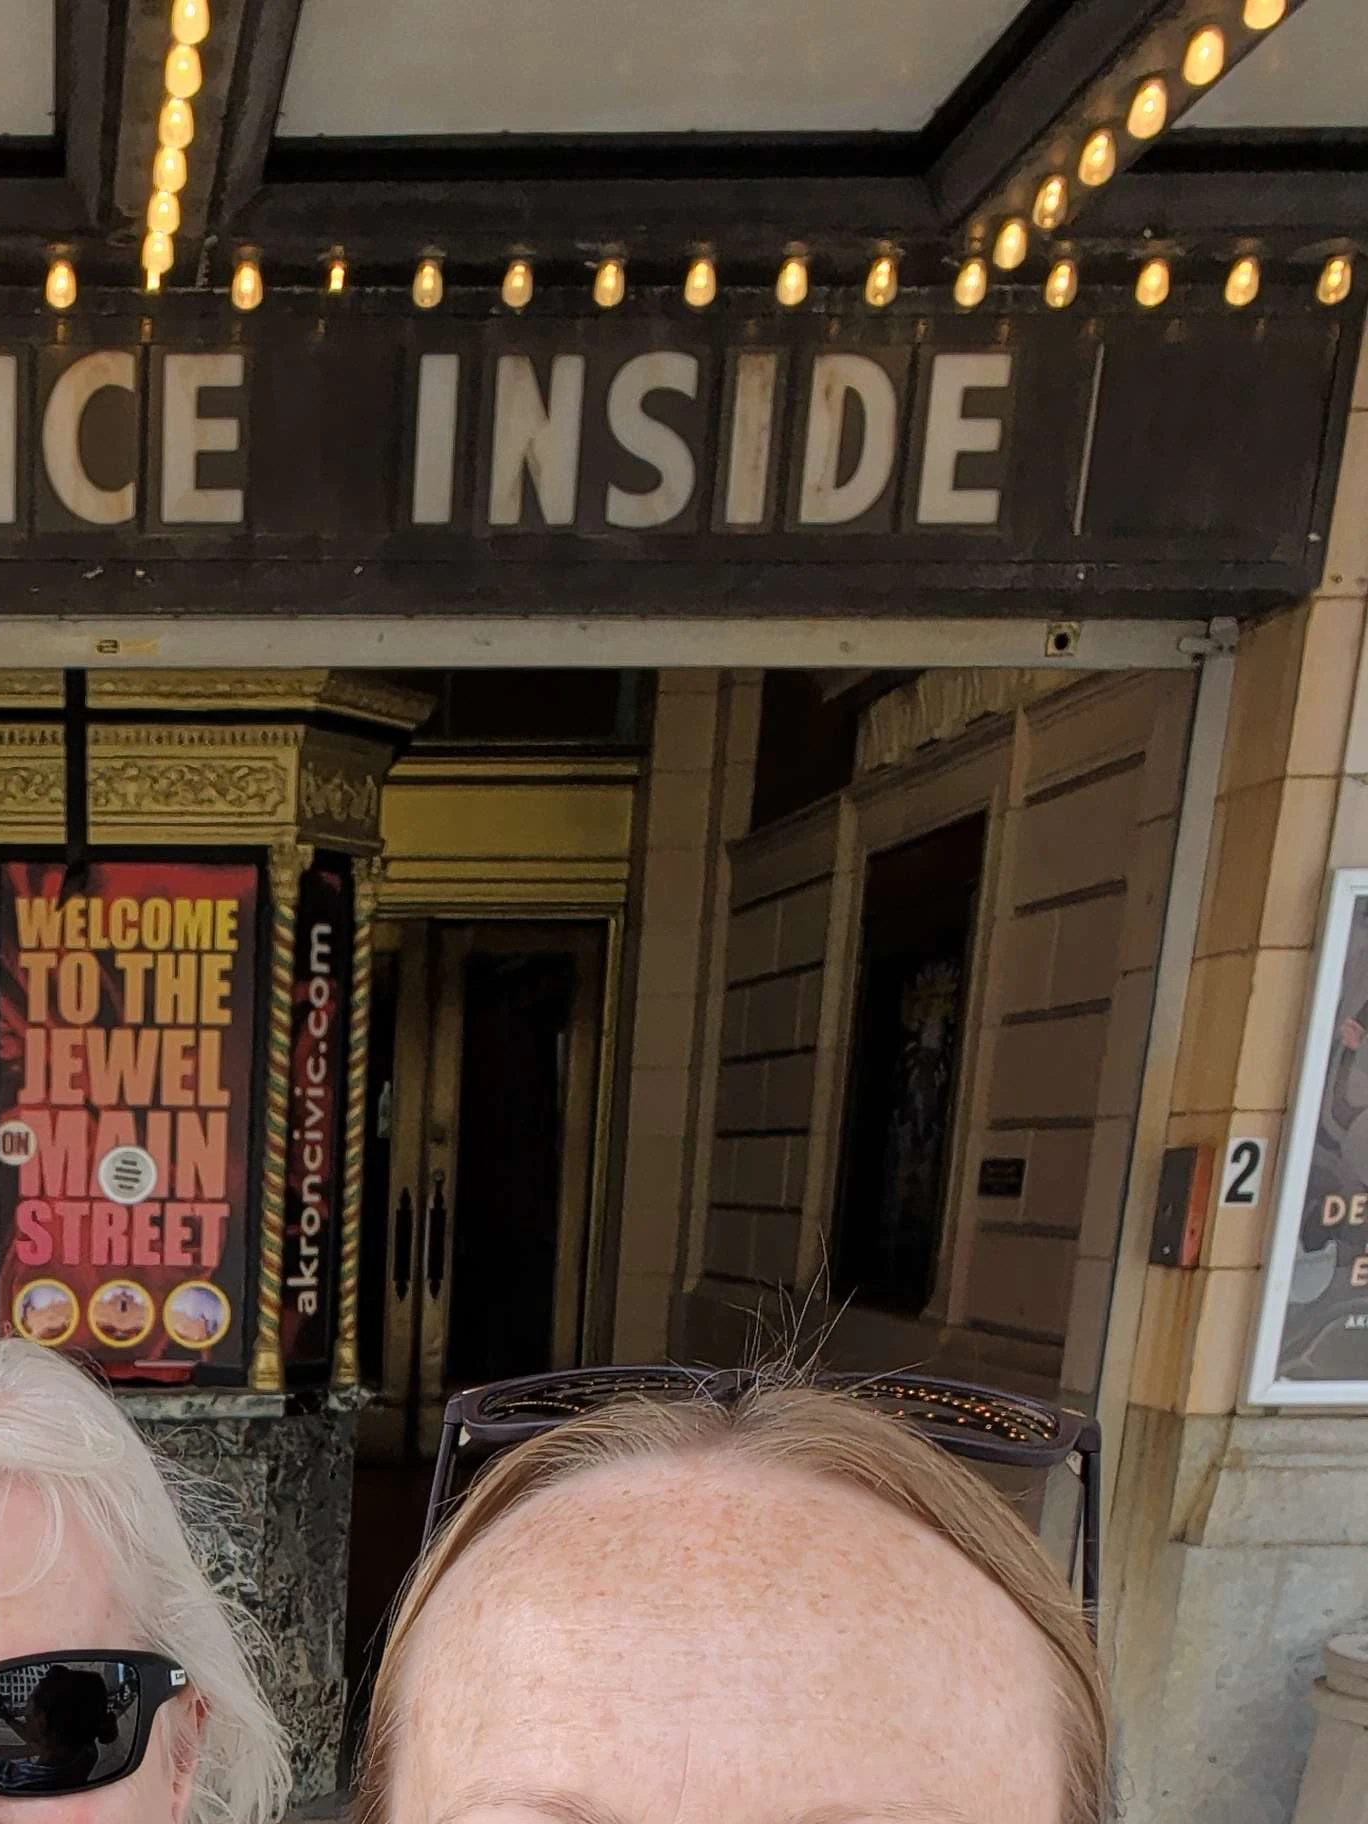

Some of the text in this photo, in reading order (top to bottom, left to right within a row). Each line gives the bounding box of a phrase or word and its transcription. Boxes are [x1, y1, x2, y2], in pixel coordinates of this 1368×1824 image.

[410, 351, 1013, 528] INSIDE
[16, 897, 238, 950] WELCOME
[18, 951, 233, 1025] TO THE
[17, 1027, 231, 1107] JEWEL
[2, 1131, 29, 1155] ON
[19, 1109, 228, 1200] MAIN
[287, 922, 332, 1317] akroncivic.com
[1224, 1140, 1261, 1203] 2
[16, 1199, 231, 1267] STREET
